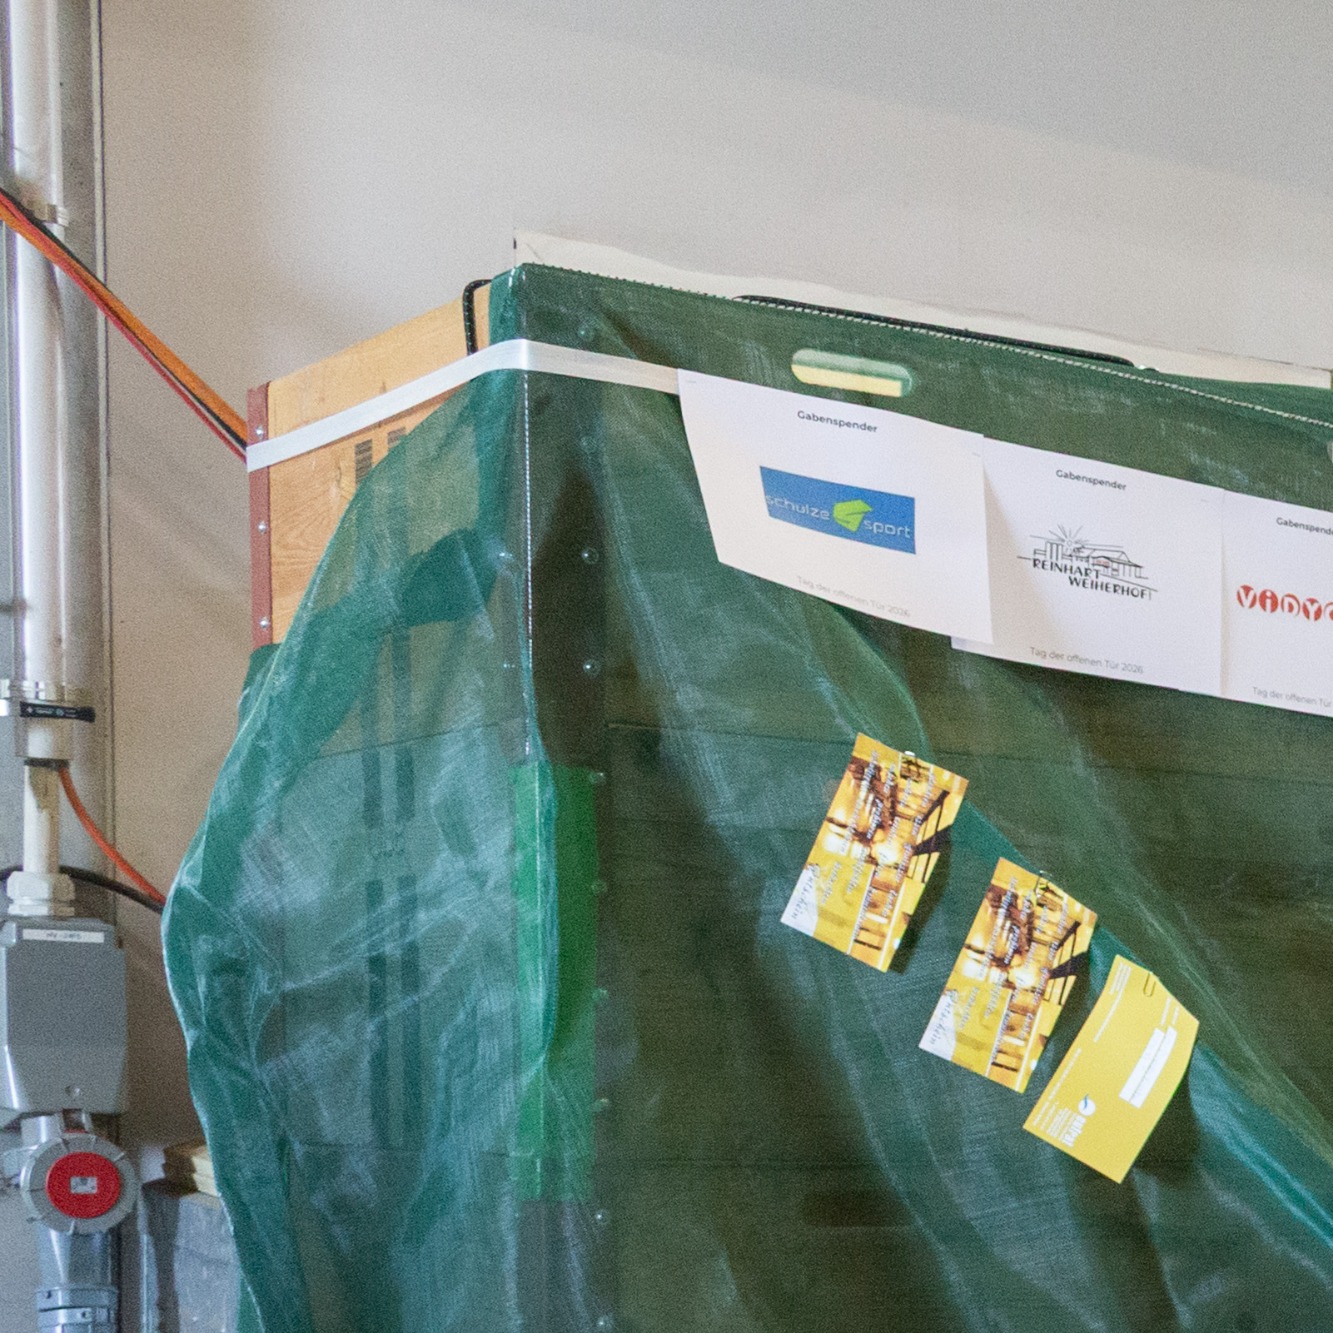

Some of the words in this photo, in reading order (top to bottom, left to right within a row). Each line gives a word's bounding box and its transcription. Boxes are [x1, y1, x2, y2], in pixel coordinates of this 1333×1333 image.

[797, 410, 878, 432] Gabenspender
[1056, 470, 1127, 490] Gabenspender
[765, 494, 830, 520] schulze
[864, 520, 911, 538] sport
[1033, 558, 1100, 579] REINHART
[1068, 576, 1147, 599] WEIHERHOF
[1030, 647, 1046, 659] Tag
[1049, 651, 1064, 661] der
[1067, 653, 1102, 667] offenen
[1104, 659, 1119, 669] Tür
[1121, 663, 1144, 674] 2026
